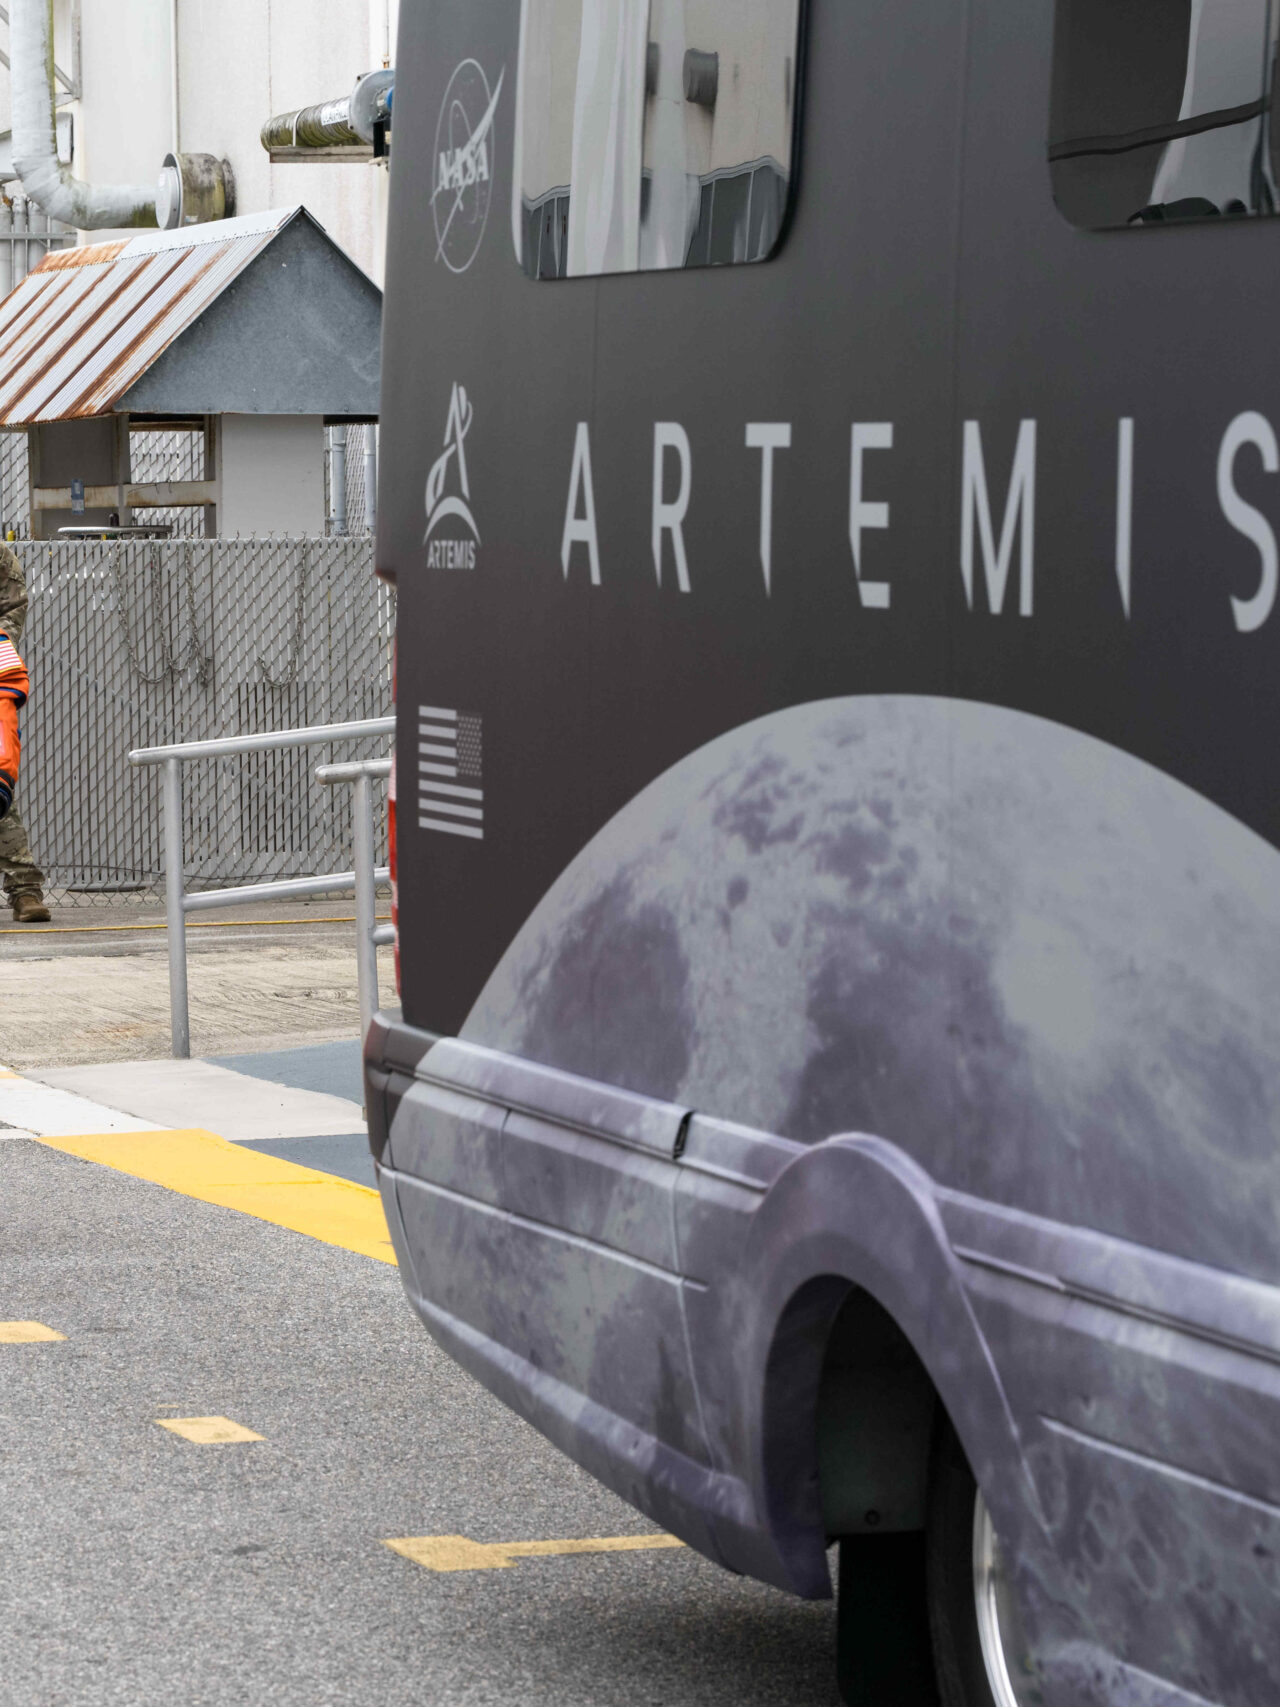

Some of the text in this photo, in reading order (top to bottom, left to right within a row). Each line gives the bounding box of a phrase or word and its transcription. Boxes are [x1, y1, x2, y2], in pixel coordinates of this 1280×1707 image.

[439, 143, 489, 190] NASA
[561, 411, 1280, 633] ARTEMIS
[427, 540, 476, 570] ARTEMIS
